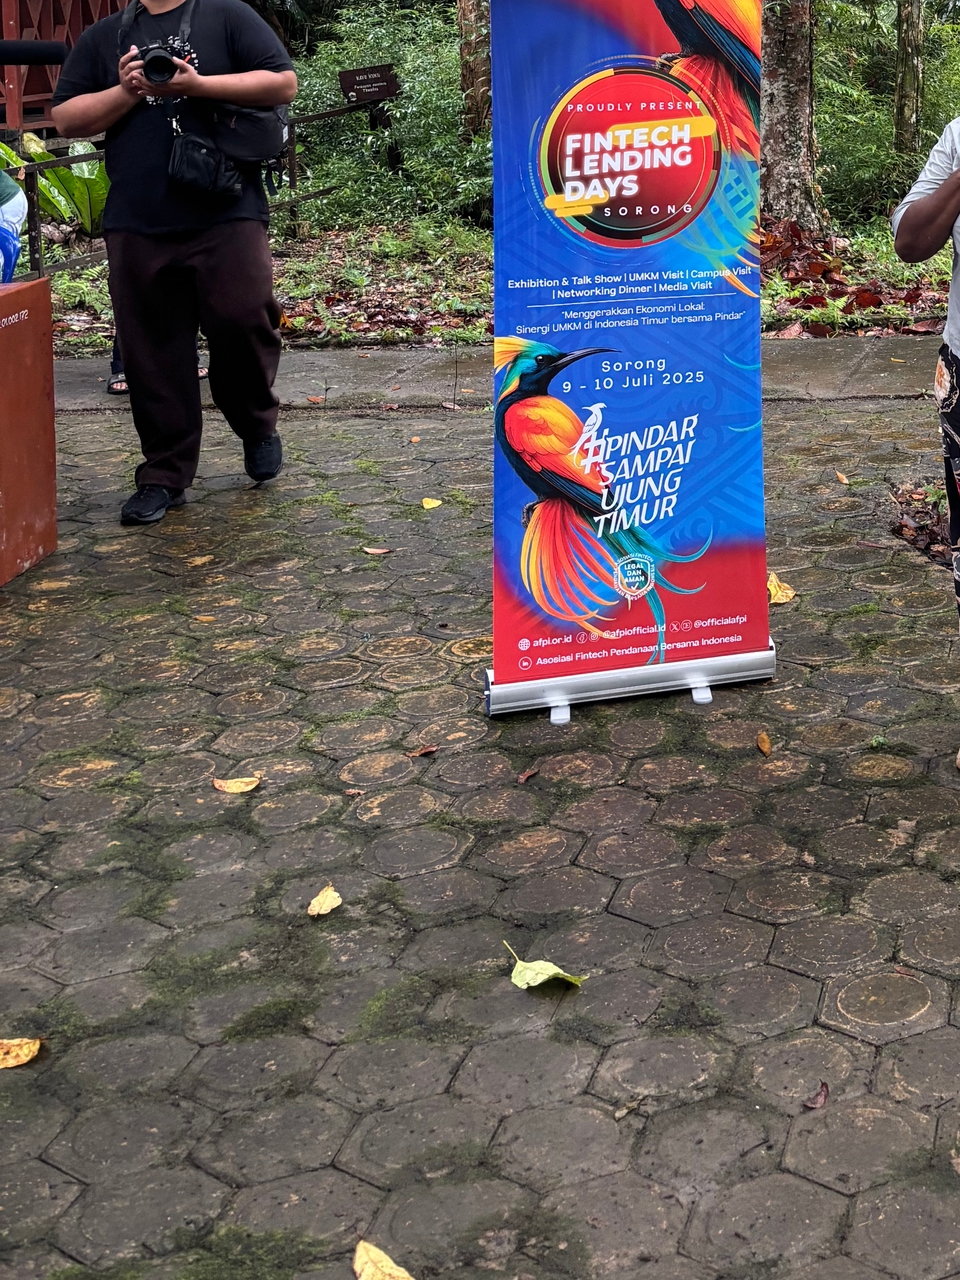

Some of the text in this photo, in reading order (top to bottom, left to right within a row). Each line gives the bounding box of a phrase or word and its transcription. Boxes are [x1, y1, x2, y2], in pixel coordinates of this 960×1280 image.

[567, 101, 702, 112] PROUDLY PRESENT
[565, 124, 690, 154] FINTECH
[565, 146, 692, 177] LENDING
[564, 175, 639, 202] DAYS
[604, 204, 693, 217] SORONG
[508, 278, 559, 289] Exhibition
[561, 277, 569, 286] &
[572, 276, 592, 285] Talk
[594, 274, 622, 284] Show
[629, 272, 659, 282] UMKM
[662, 270, 684, 279] Visit
[690, 268, 730, 279] Campus
[732, 266, 751, 276] Visit
[557, 286, 616, 299] Networking
[619, 284, 652, 294] Dinner
[659, 282, 688, 291] Media
[690, 280, 712, 290] Visit
[636, 303, 676, 313] Ekonomi
[516, 324, 550, 335] Sinergi
[552, 322, 582, 332] UMKM
[584, 320, 592, 330] di
[594, 318, 639, 329] Indonesia
[641, 316, 669, 326] Timur
[671, 313, 712, 324] bersama
[602, 358, 666, 372] Sorong
[562, 382, 571, 392] 9
[595, 378, 614, 390] 10
[622, 374, 653, 388] Juli
[662, 371, 704, 385] 2025
[599, 439, 696, 486] SAMPAI
[600, 468, 683, 511] UJUNG
[593, 494, 678, 538] TIMUR
[533, 615, 747, 647] afpi.or.id @afpiofficial.id @officialafpi
[536, 634, 742, 666] Asosiasi Fintech Pendanaan Bersama Indonesia
